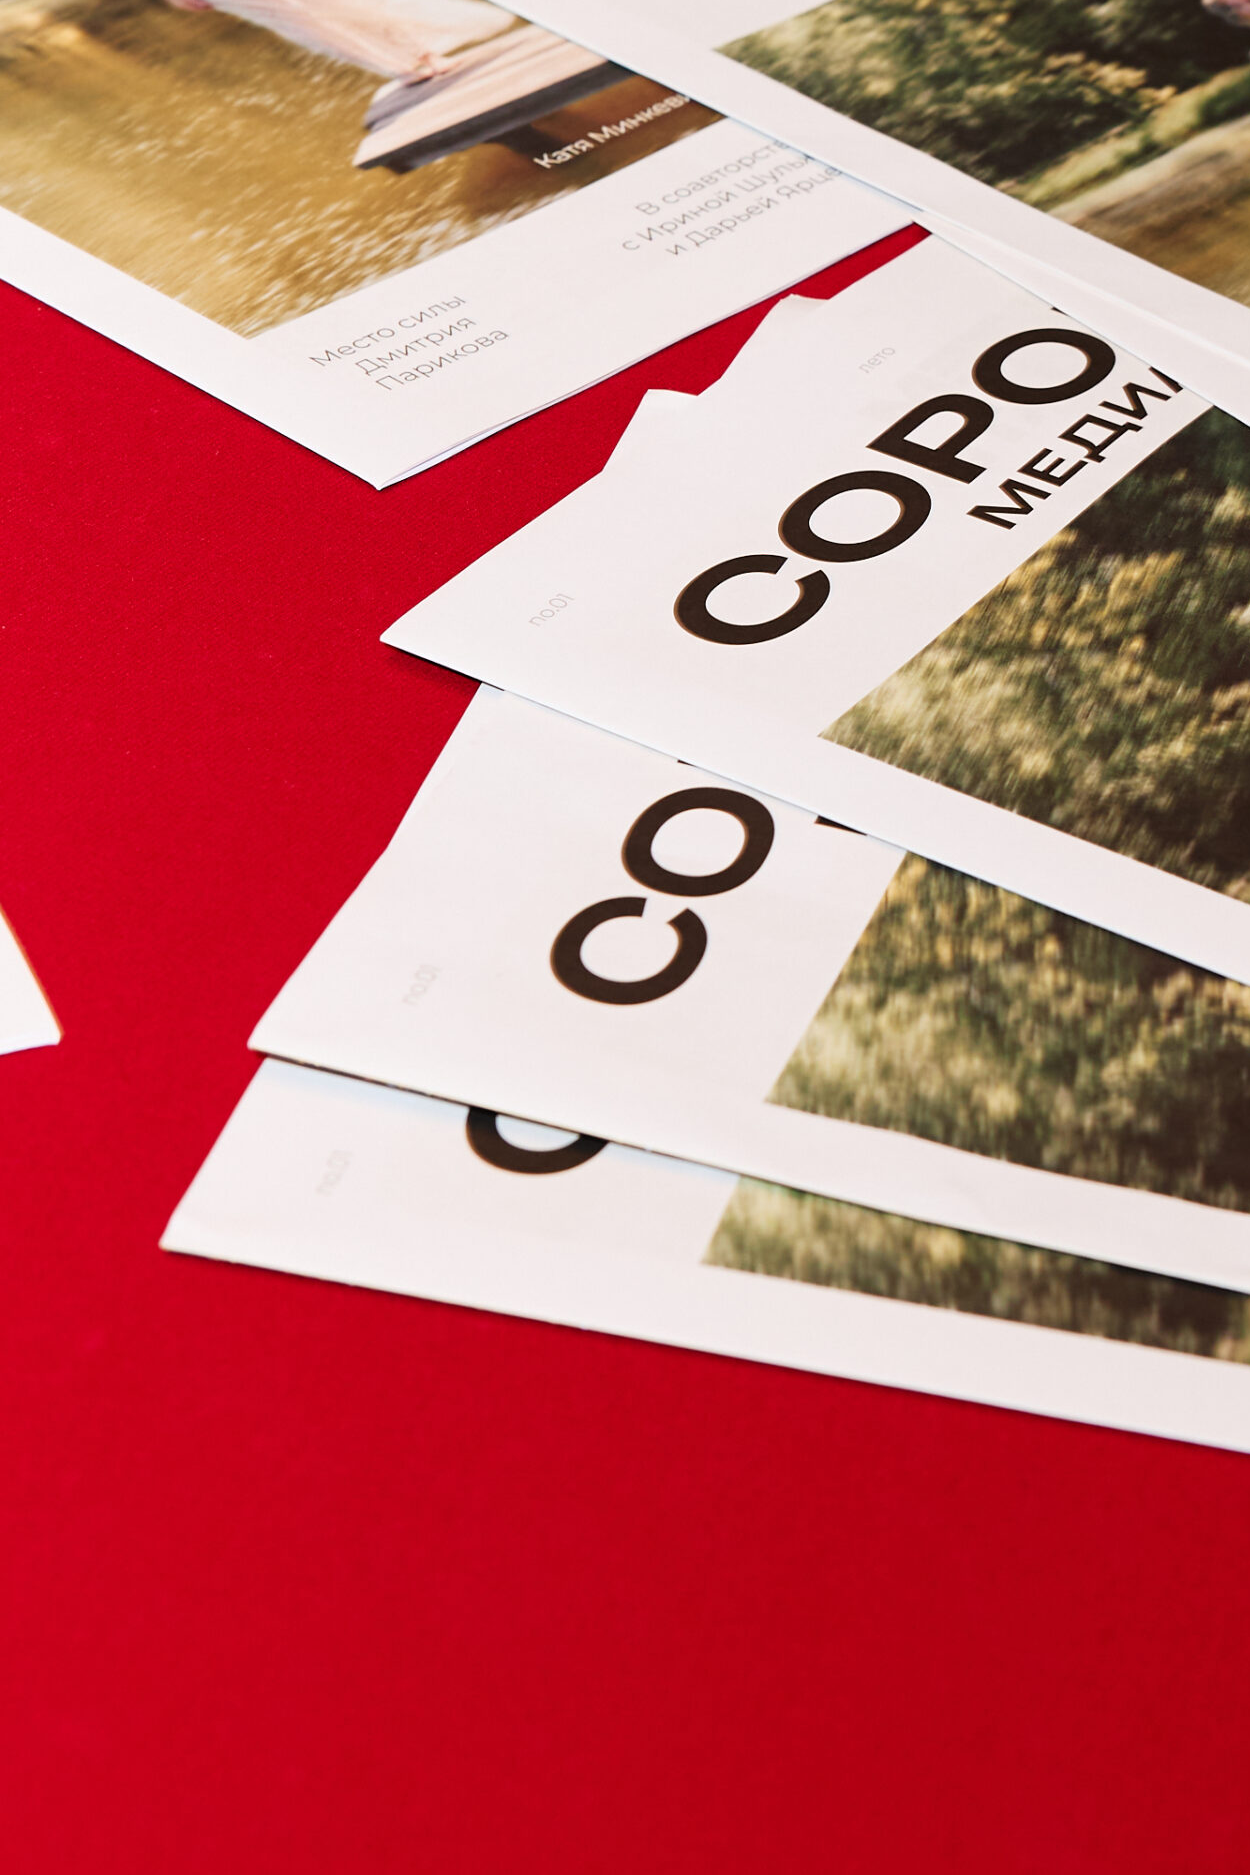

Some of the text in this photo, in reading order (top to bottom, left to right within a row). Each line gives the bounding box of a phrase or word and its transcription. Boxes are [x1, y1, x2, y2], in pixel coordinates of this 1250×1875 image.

[533, 137, 594, 170] Катя
[621, 237, 641, 253] с
[636, 189, 739, 242] Ириной
[634, 200, 661, 217] В
[665, 242, 689, 257] и
[684, 195, 781, 249] Дарьей
[308, 295, 468, 368] Место силы
[354, 317, 477, 377] Дмитрия
[375, 328, 510, 391] Парикова
[673, 306, 1117, 646] СОРО
[527, 591, 578, 629] no.01
